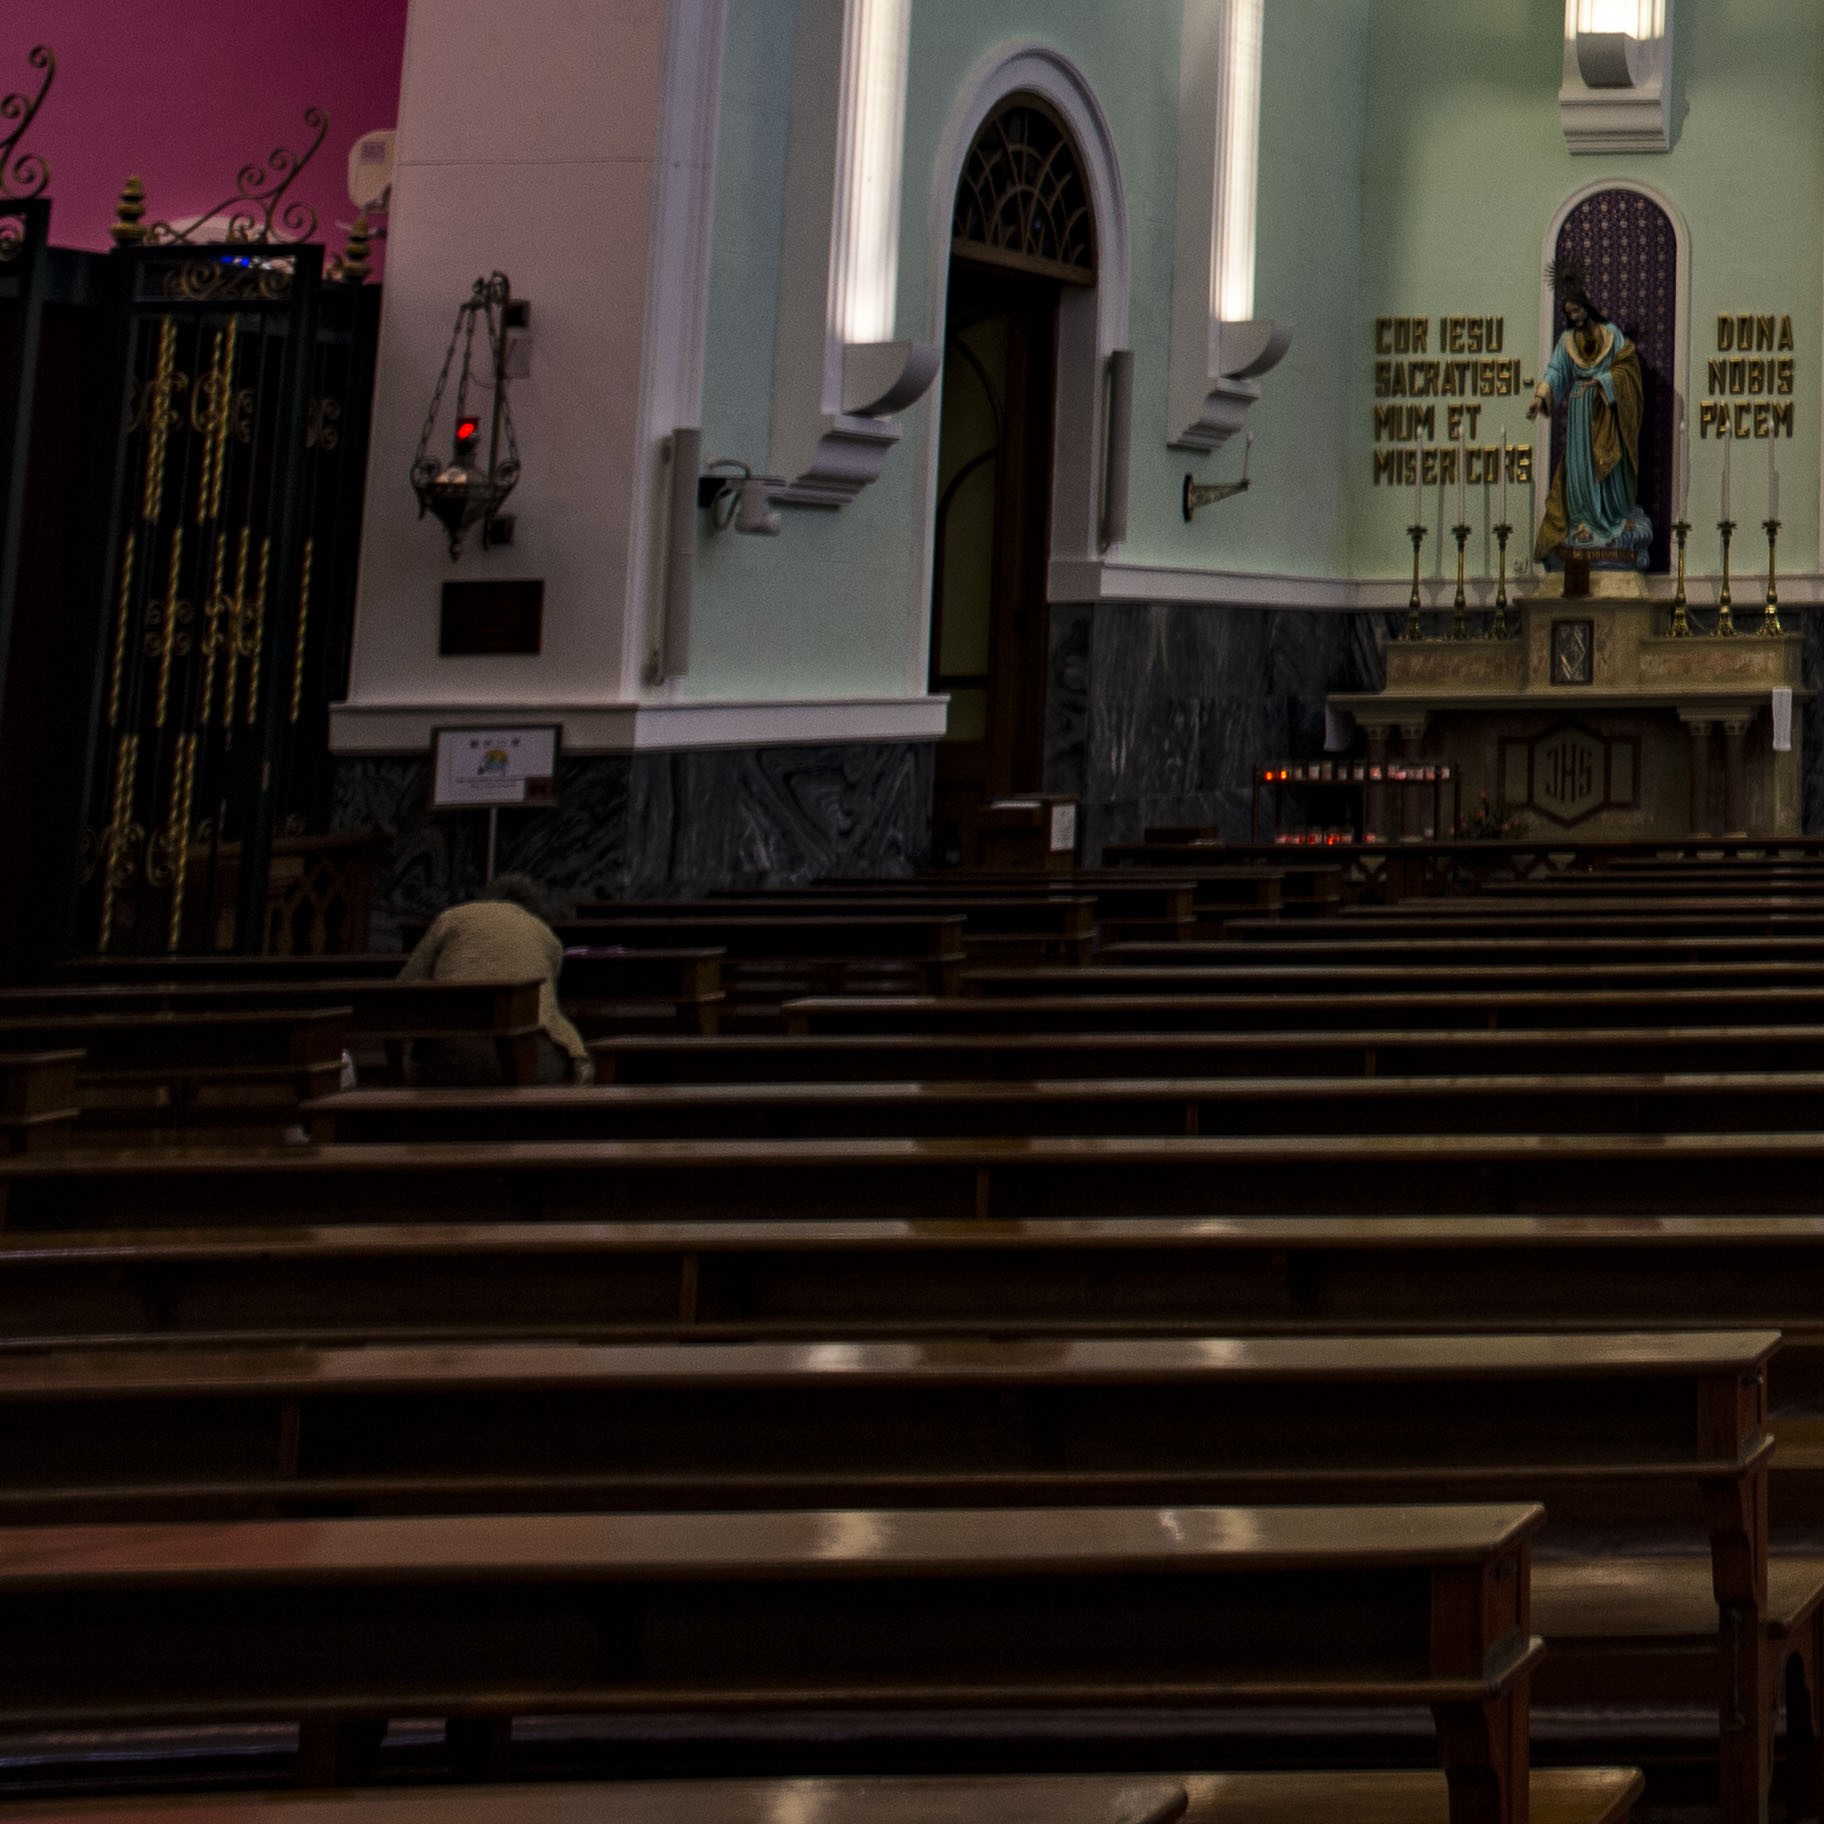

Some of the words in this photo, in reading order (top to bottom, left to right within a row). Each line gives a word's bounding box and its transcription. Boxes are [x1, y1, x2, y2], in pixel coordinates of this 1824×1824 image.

[1376, 316, 1428, 354] COR
[1440, 316, 1504, 353] IESU
[1717, 312, 1794, 352] DONA
[1376, 359, 1535, 397] SACRATISSI-
[1708, 356, 1794, 396] NOBIS
[1374, 404, 1435, 442] MUM
[1447, 403, 1481, 441] ET
[1700, 400, 1794, 439] PACEM
[1374, 444, 1533, 485] MISERCORS
